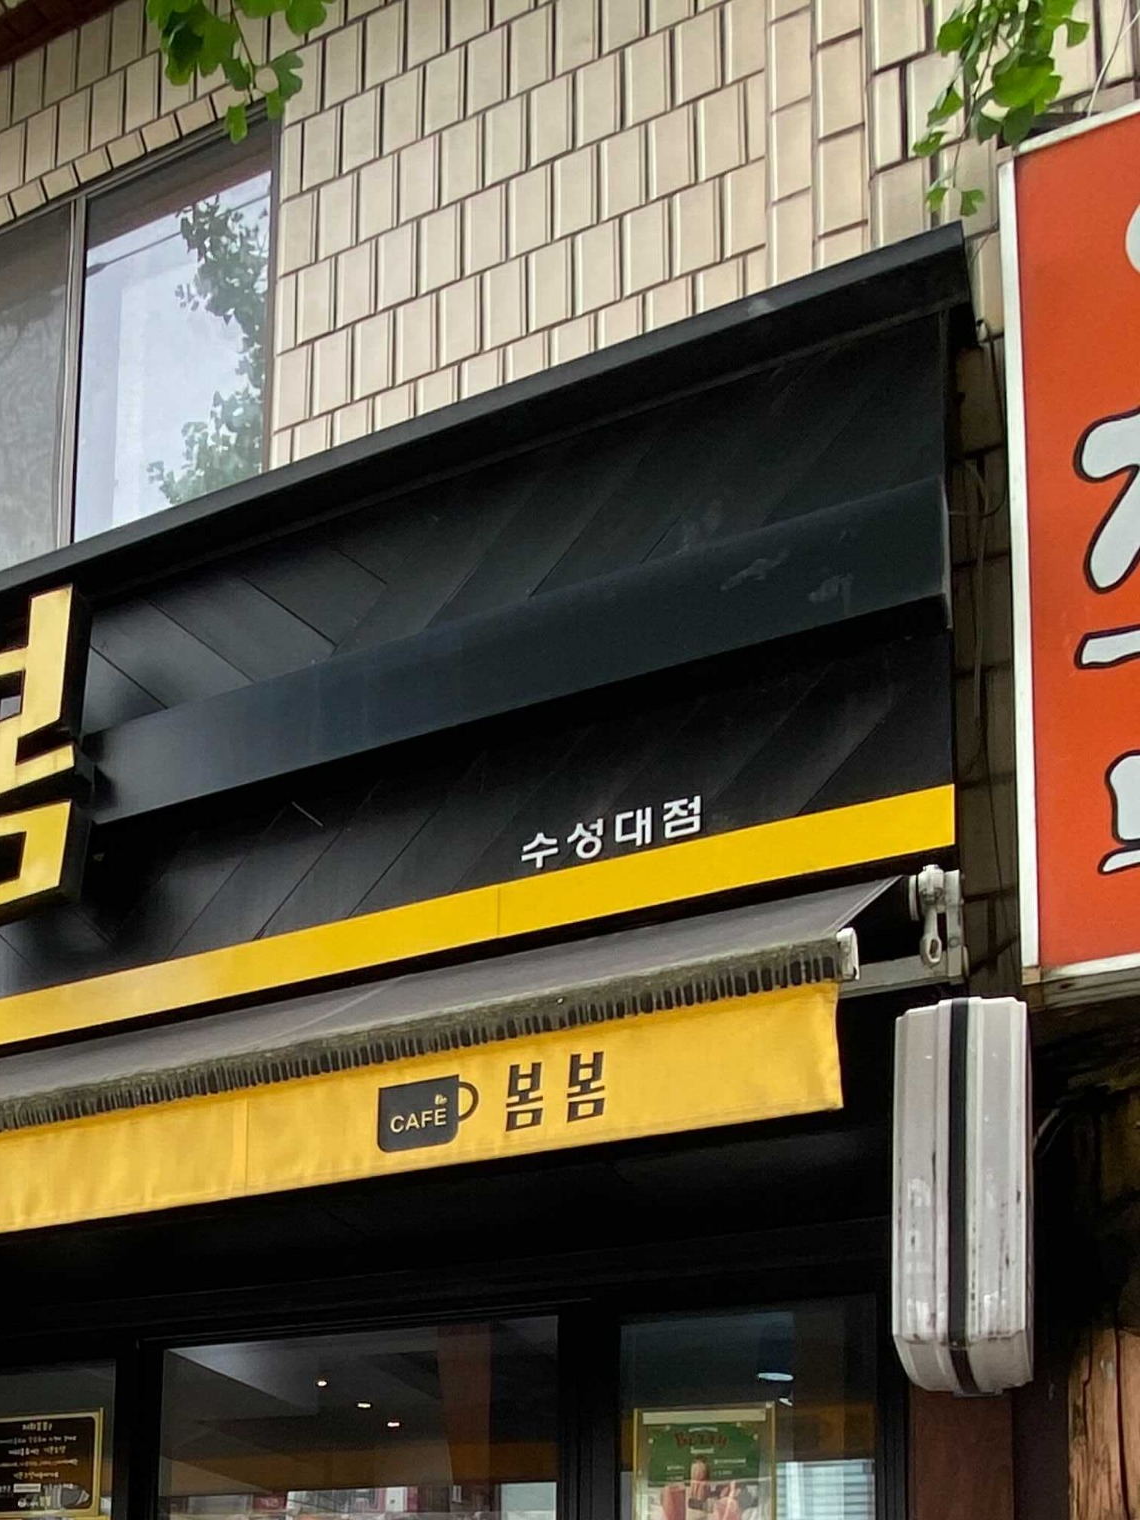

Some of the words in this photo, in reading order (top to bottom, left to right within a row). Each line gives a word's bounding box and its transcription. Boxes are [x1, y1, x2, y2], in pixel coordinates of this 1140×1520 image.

[521, 796, 703, 869] 수성대점
[389, 1107, 448, 1134] CAFE
[505, 1051, 606, 1132] 봄봄
